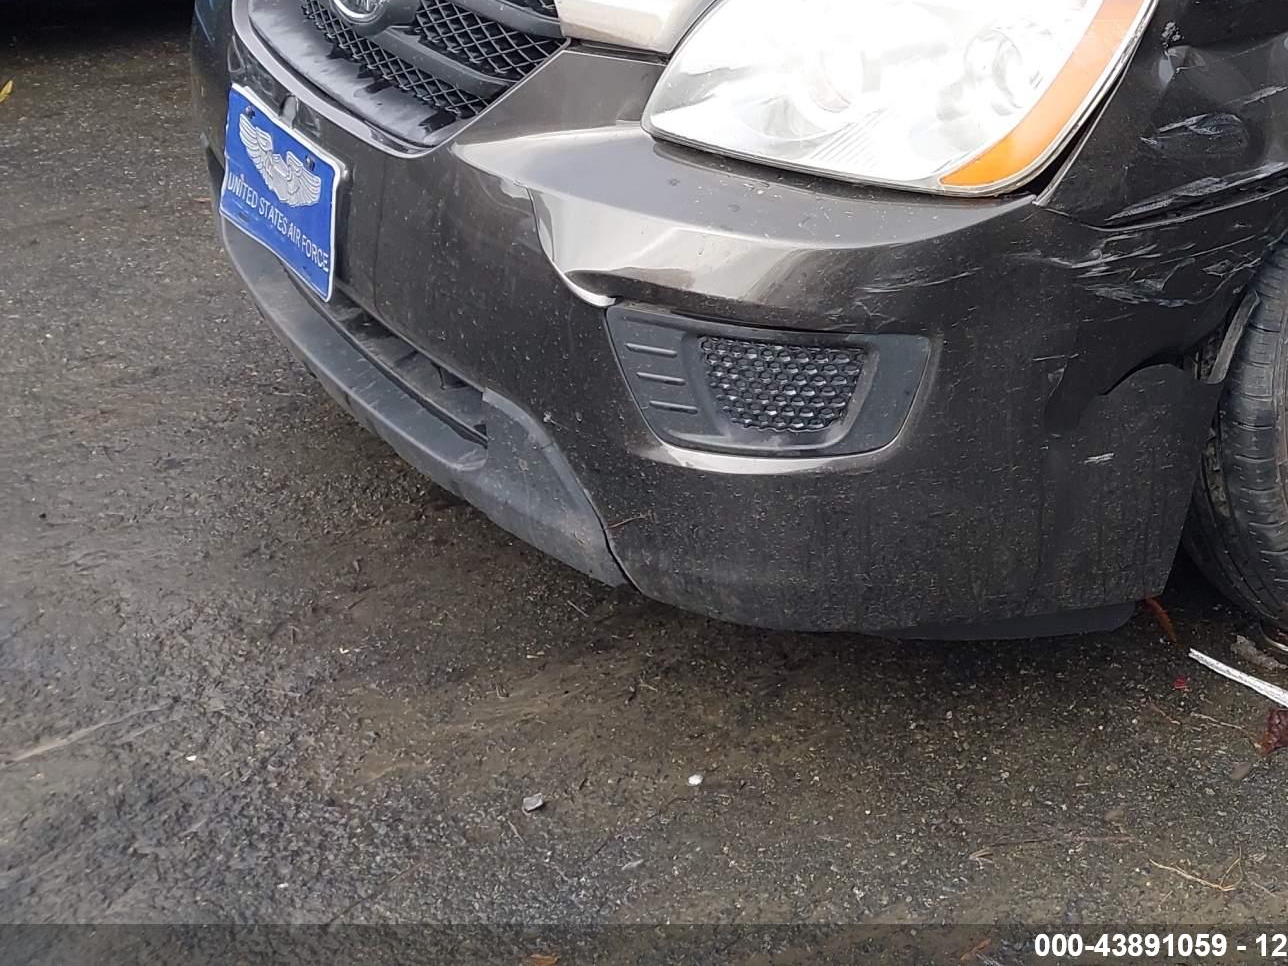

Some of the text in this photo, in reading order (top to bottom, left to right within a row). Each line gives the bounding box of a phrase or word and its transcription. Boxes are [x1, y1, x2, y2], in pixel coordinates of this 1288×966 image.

[227, 170, 330, 272] UNITED STATES AIR FORCE
